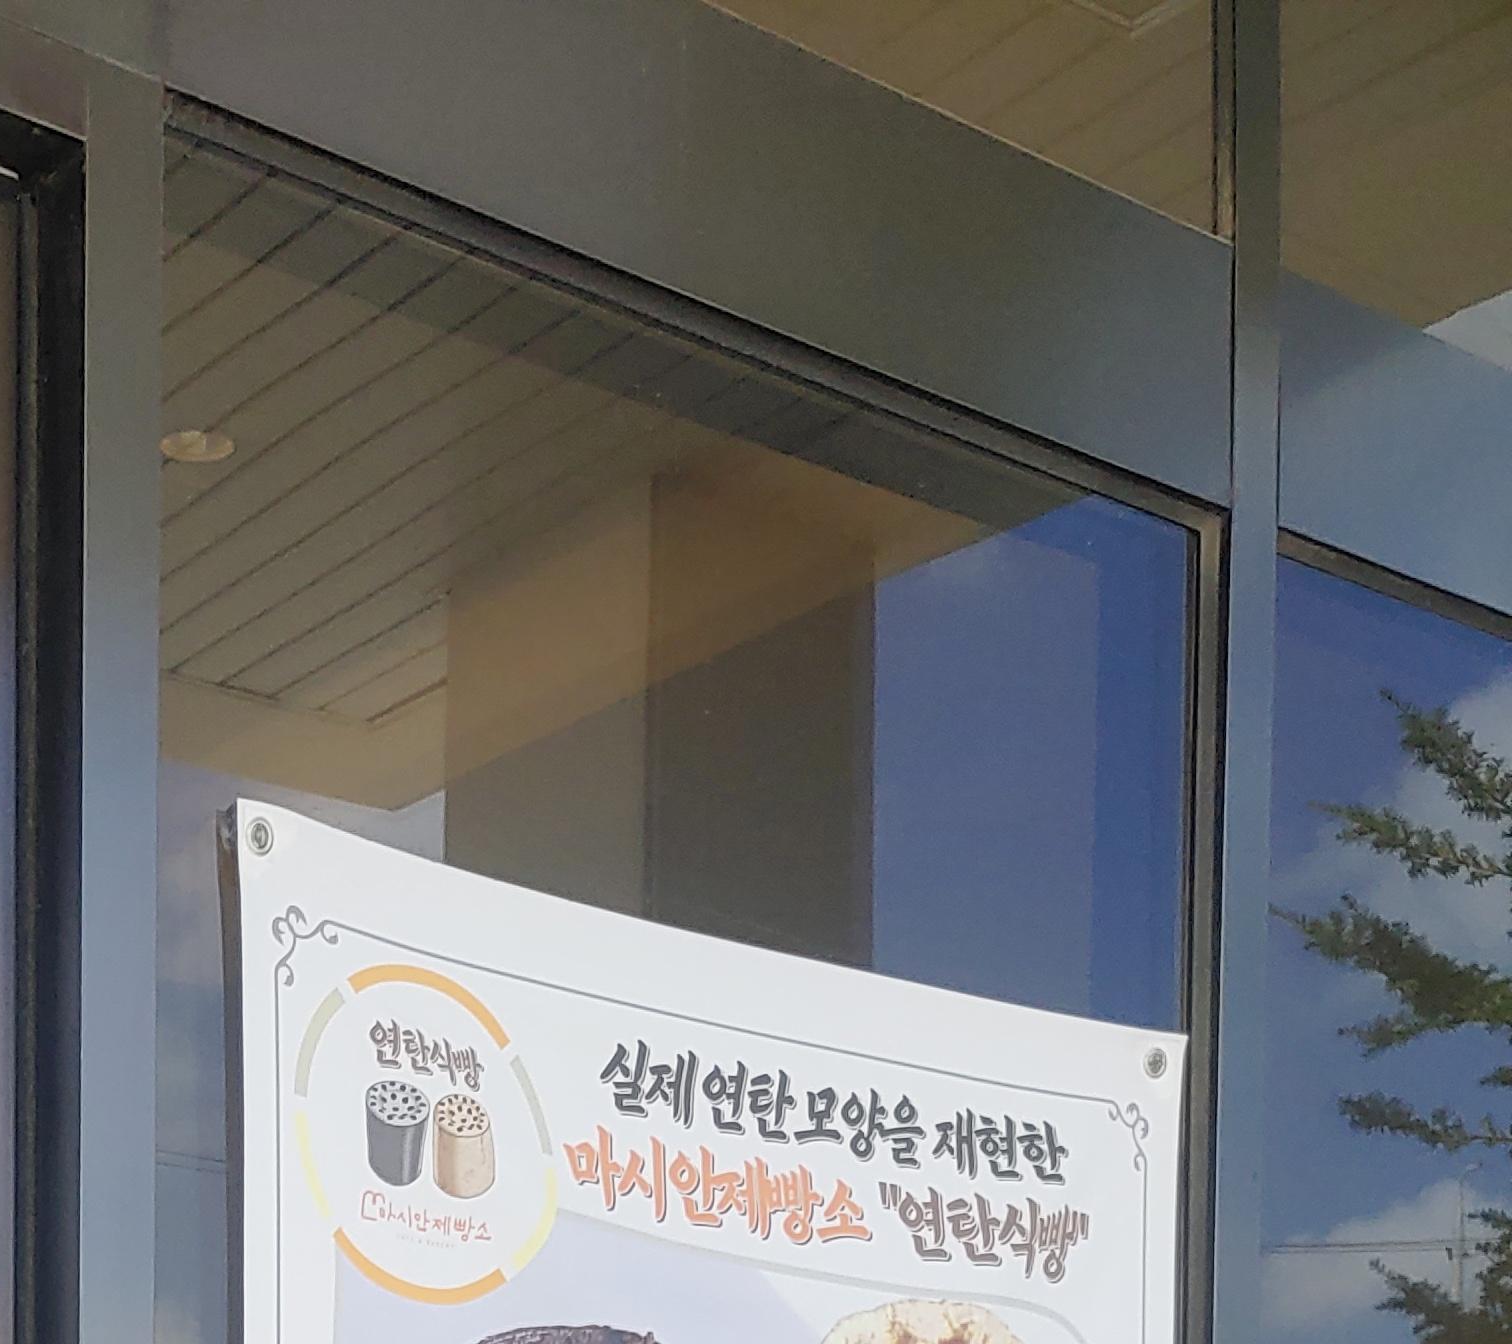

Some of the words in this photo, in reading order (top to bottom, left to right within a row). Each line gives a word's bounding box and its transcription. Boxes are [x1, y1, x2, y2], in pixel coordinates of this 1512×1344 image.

[369, 1018, 485, 1092] 연탄식빵
[599, 1038, 699, 1128] 실제
[702, 1060, 795, 1141] 연탄
[793, 1086, 925, 1168] 모양을
[933, 1107, 1070, 1184] 재현한
[372, 1197, 492, 1242] 마시안제빵소
[562, 1125, 873, 1246] 마시안제빵소
